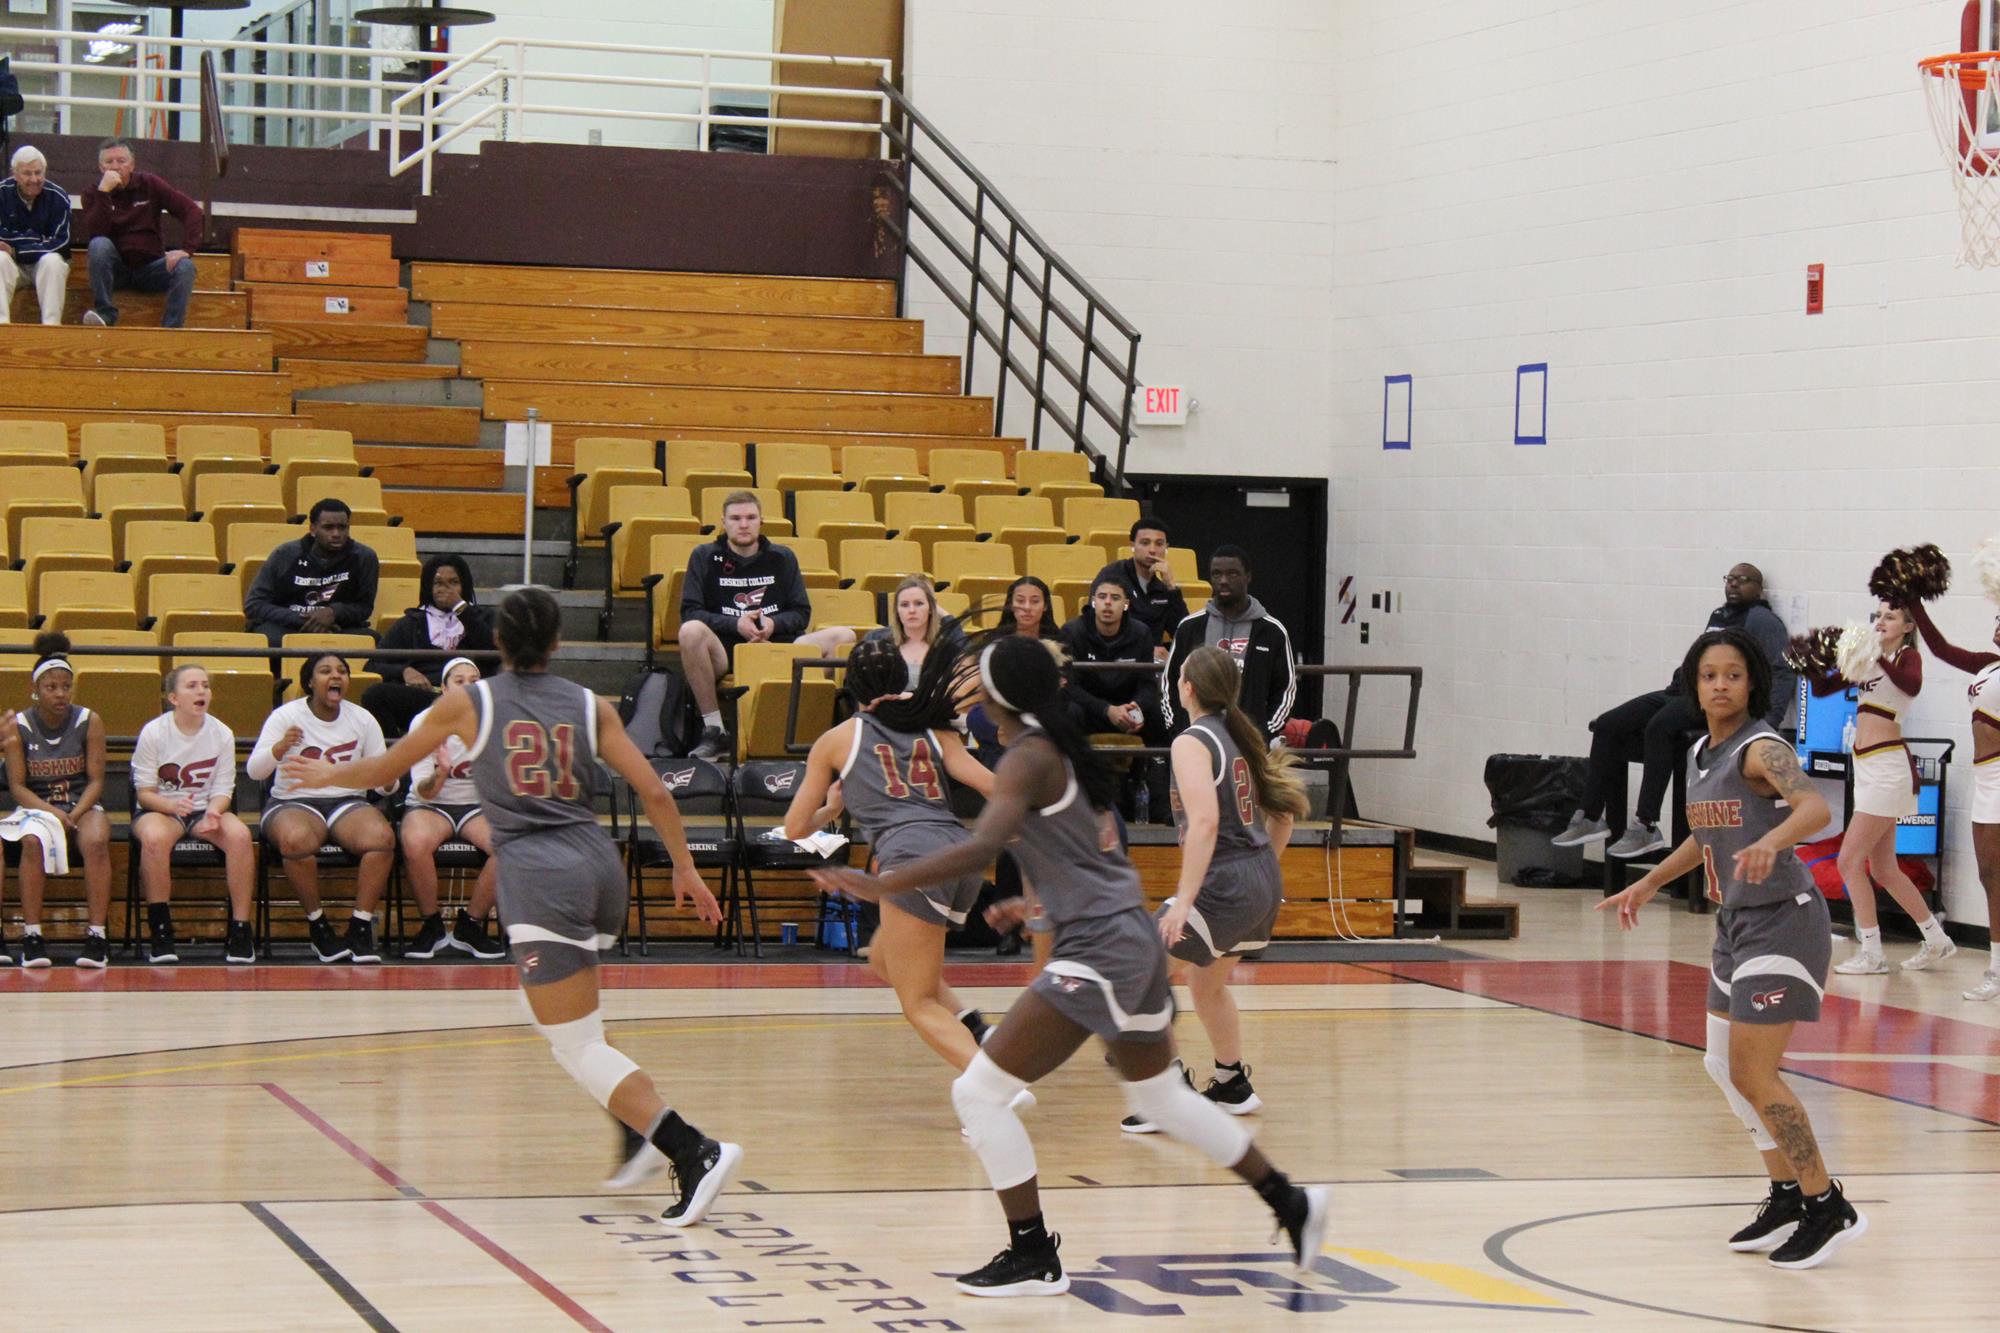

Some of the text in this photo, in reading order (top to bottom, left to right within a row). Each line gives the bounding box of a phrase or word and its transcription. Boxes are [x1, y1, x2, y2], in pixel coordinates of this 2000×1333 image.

[1146, 387, 1180, 414] EXIT
[719, 575, 775, 587] ERSKINE COLLEGE
[1799, 676, 1807, 740] OWERADE
[503, 719, 580, 800] 21
[874, 737, 943, 800] 14
[1896, 815, 1936, 825] OWERADE
[438, 843, 477, 852] ERSKINE
[1702, 844, 1724, 905] 1
